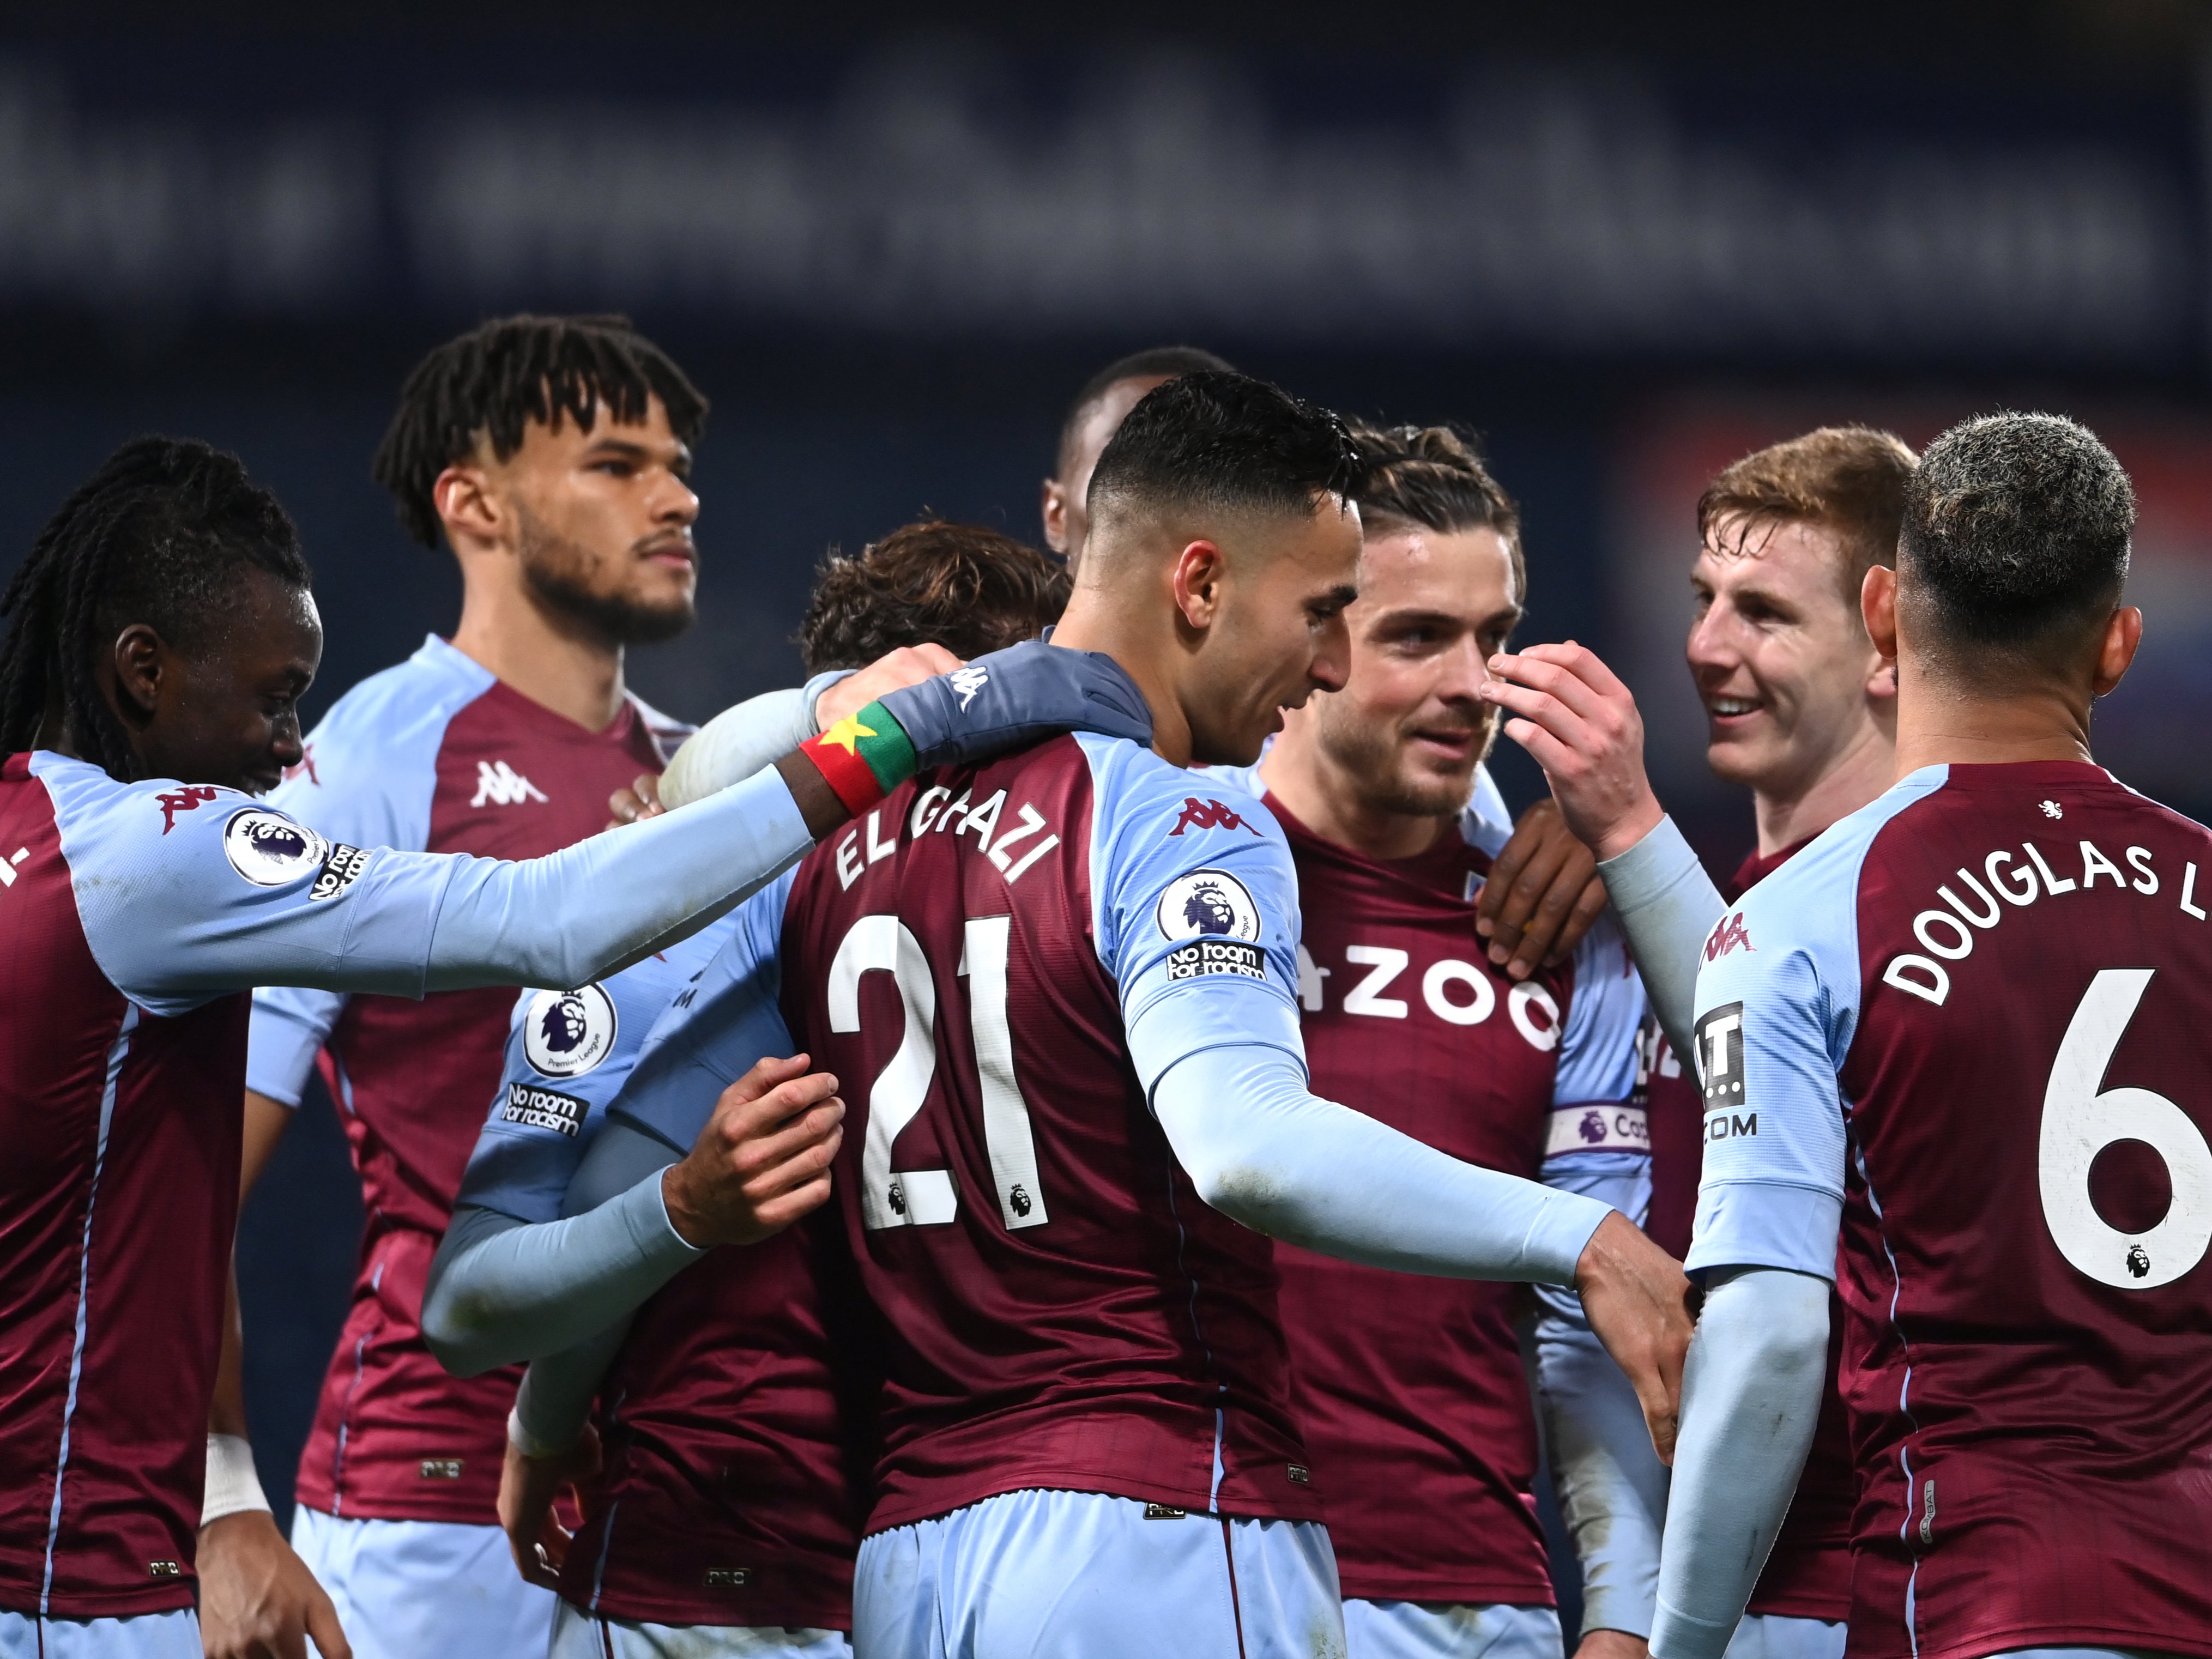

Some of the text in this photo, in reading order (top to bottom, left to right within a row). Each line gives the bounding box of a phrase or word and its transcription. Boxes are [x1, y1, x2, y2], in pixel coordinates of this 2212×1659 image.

[837, 809, 896, 892] EL
[1236, 915, 1250, 940] League
[1882, 840, 2211, 1007] DOUGLAS L
[1167, 943, 1256, 966] No room
[1167, 960, 1267, 981] for racism
[547, 1032, 601, 1068] Premier League
[827, 914, 1049, 1230] 21
[509, 1082, 577, 1117] No room
[521, 1108, 579, 1137] racism
[1703, 1113, 1757, 1146] OM
[2038, 968, 2212, 1289] 6
